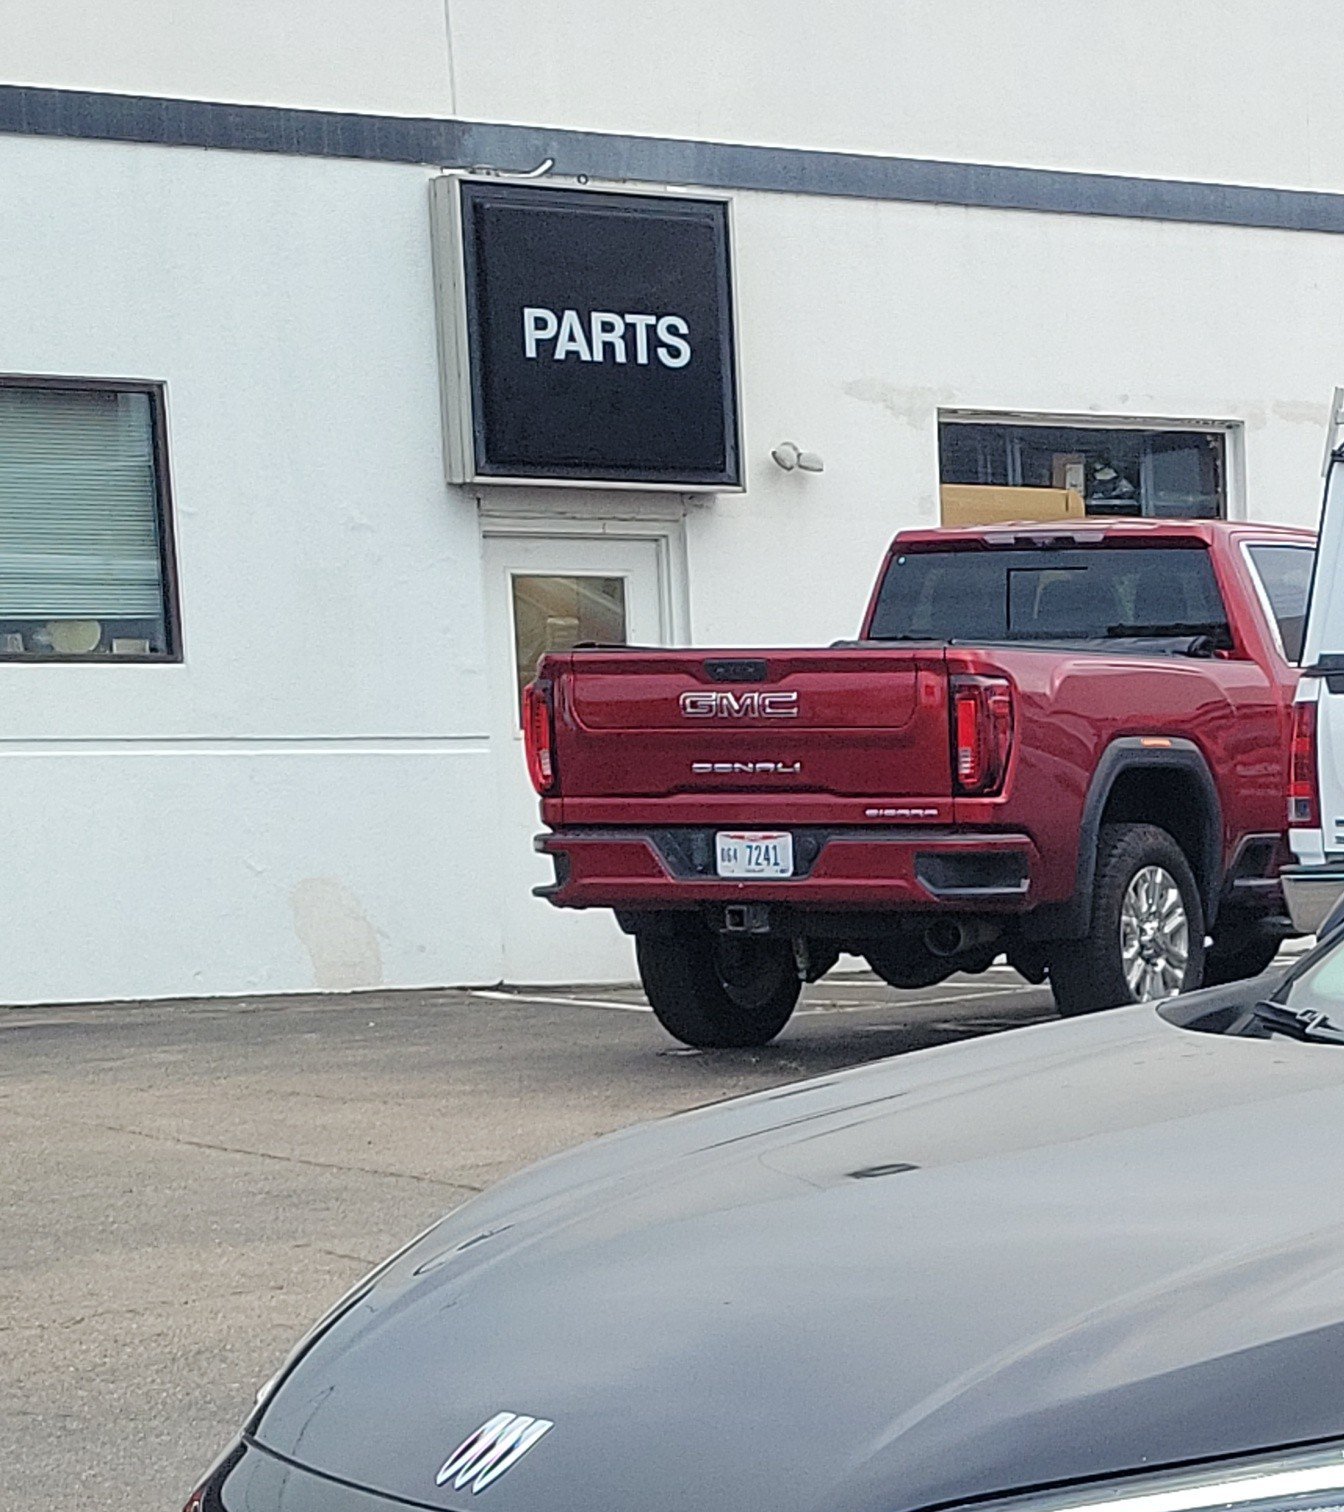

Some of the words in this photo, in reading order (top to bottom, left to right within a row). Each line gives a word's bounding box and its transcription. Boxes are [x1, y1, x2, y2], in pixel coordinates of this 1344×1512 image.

[523, 307, 692, 368] PARTS
[679, 691, 798, 718] GMC
[691, 761, 801, 773] DENALI
[745, 844, 781, 867] 7241
